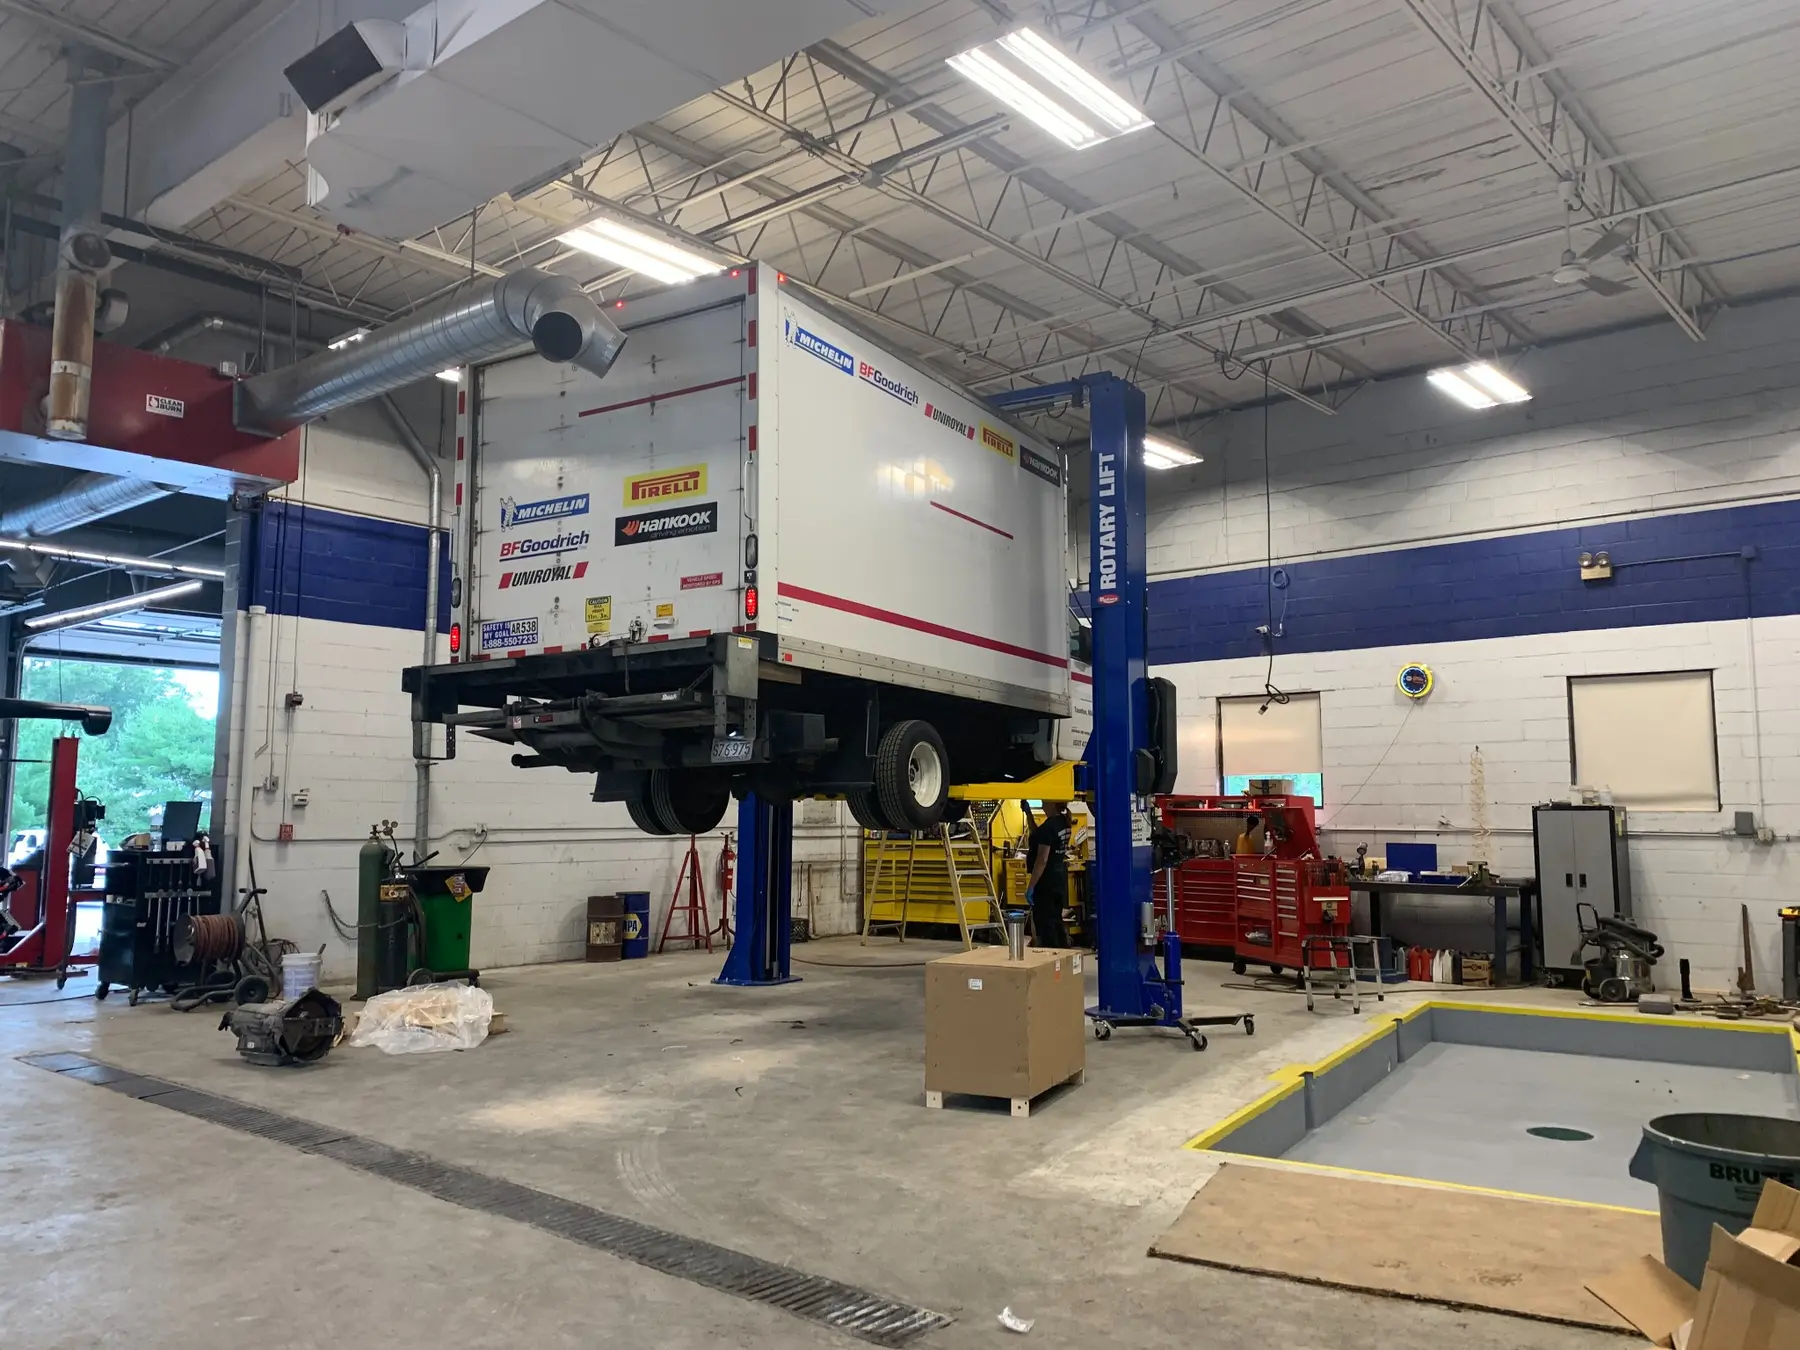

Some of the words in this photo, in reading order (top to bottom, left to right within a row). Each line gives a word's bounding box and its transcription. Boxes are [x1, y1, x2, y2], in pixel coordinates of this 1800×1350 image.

[800, 333, 852, 369] MICHELIN
[860, 361, 919, 404] BFGoodrich
[160, 398, 182, 406] CLEAN
[160, 404, 182, 412] BURN
[932, 408, 967, 437] UNIROYAL
[983, 427, 1013, 457] PIRELLI
[631, 470, 700, 501] PIRELLI
[1099, 453, 1115, 497] LIFT
[517, 498, 587, 520] MICHELIN
[500, 530, 589, 557] BFGoodrich
[650, 530, 677, 539] driving
[678, 525, 711, 534] emotion
[1099, 504, 1117, 590] ROTARY
[511, 565, 573, 587] UNIROYAL
[483, 622, 503, 632] SAFETY
[484, 632, 492, 640] MY
[495, 630, 509, 638] GOAL
[511, 620, 537, 635] AR538
